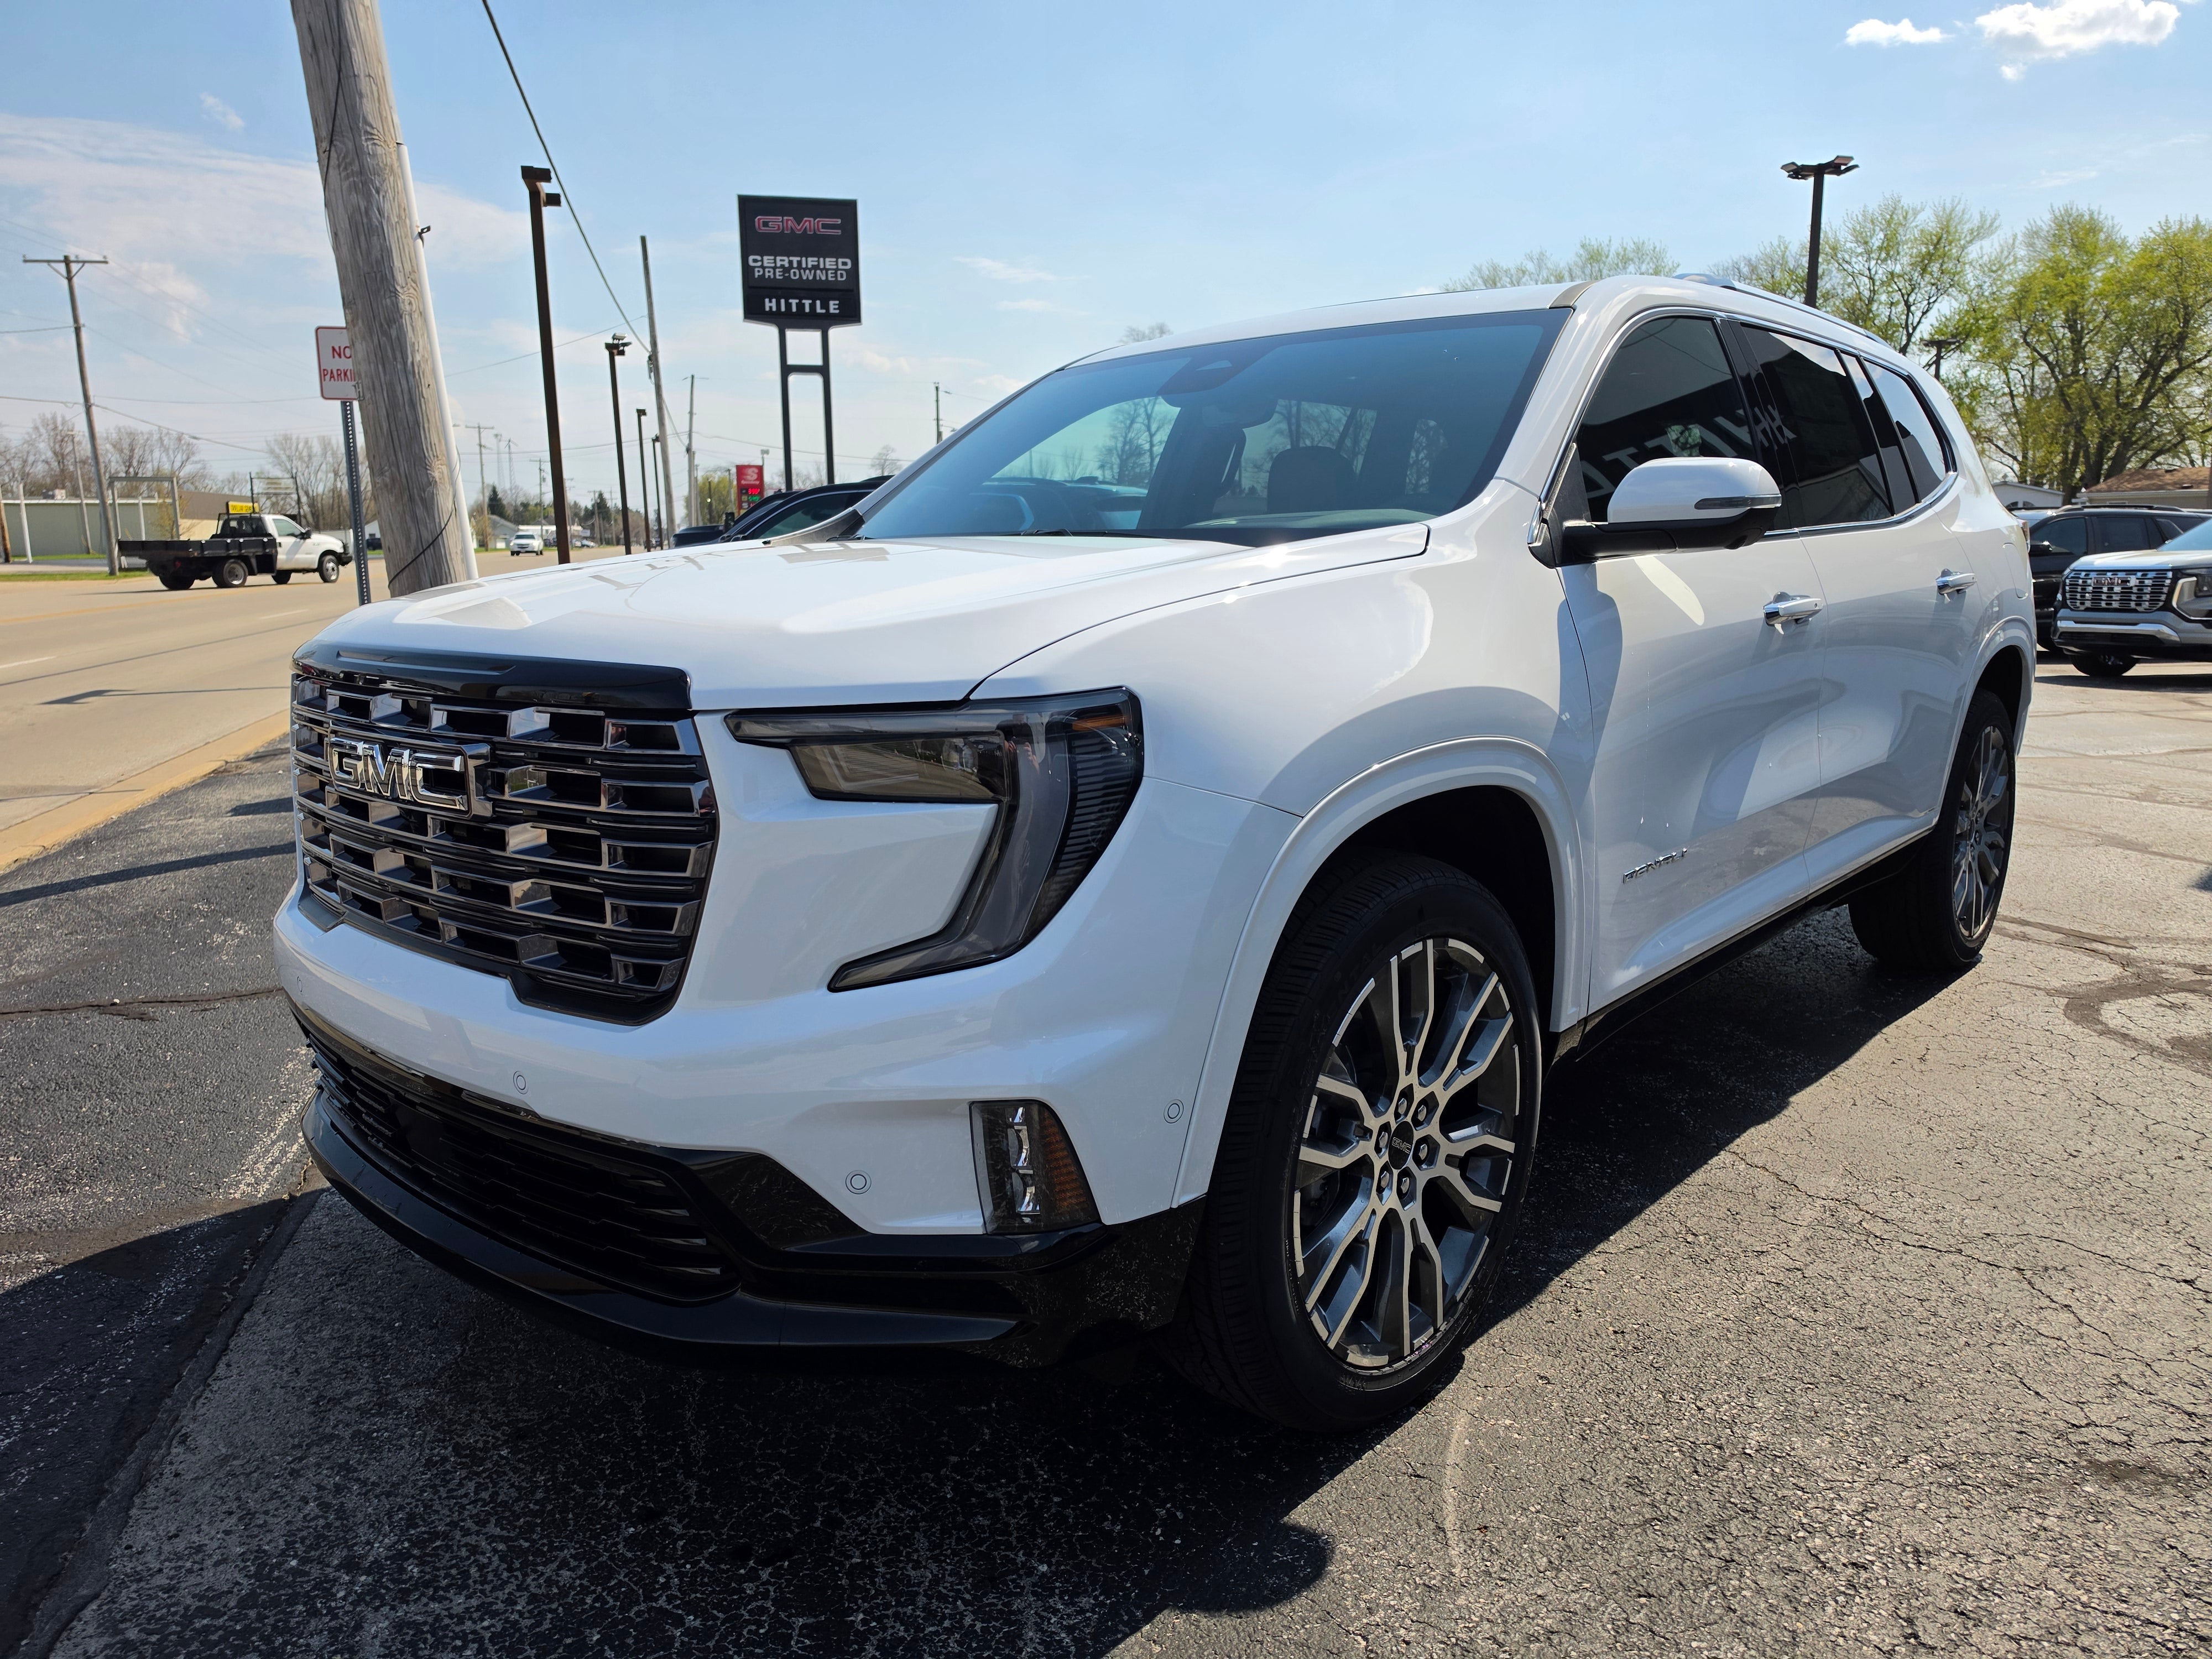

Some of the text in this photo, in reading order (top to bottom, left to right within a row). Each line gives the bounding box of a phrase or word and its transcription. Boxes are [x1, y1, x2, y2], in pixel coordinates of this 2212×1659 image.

[755, 216, 842, 234] GMC
[748, 255, 852, 269] CERTIFIED
[754, 268, 847, 281] PRE-OWNED
[764, 298, 840, 313] HITTLE
[322, 368, 356, 382] PARKI
[2093, 577, 2131, 586] GMC
[328, 737, 466, 811] GMC
[1392, 1137, 1411, 1154] GMC
